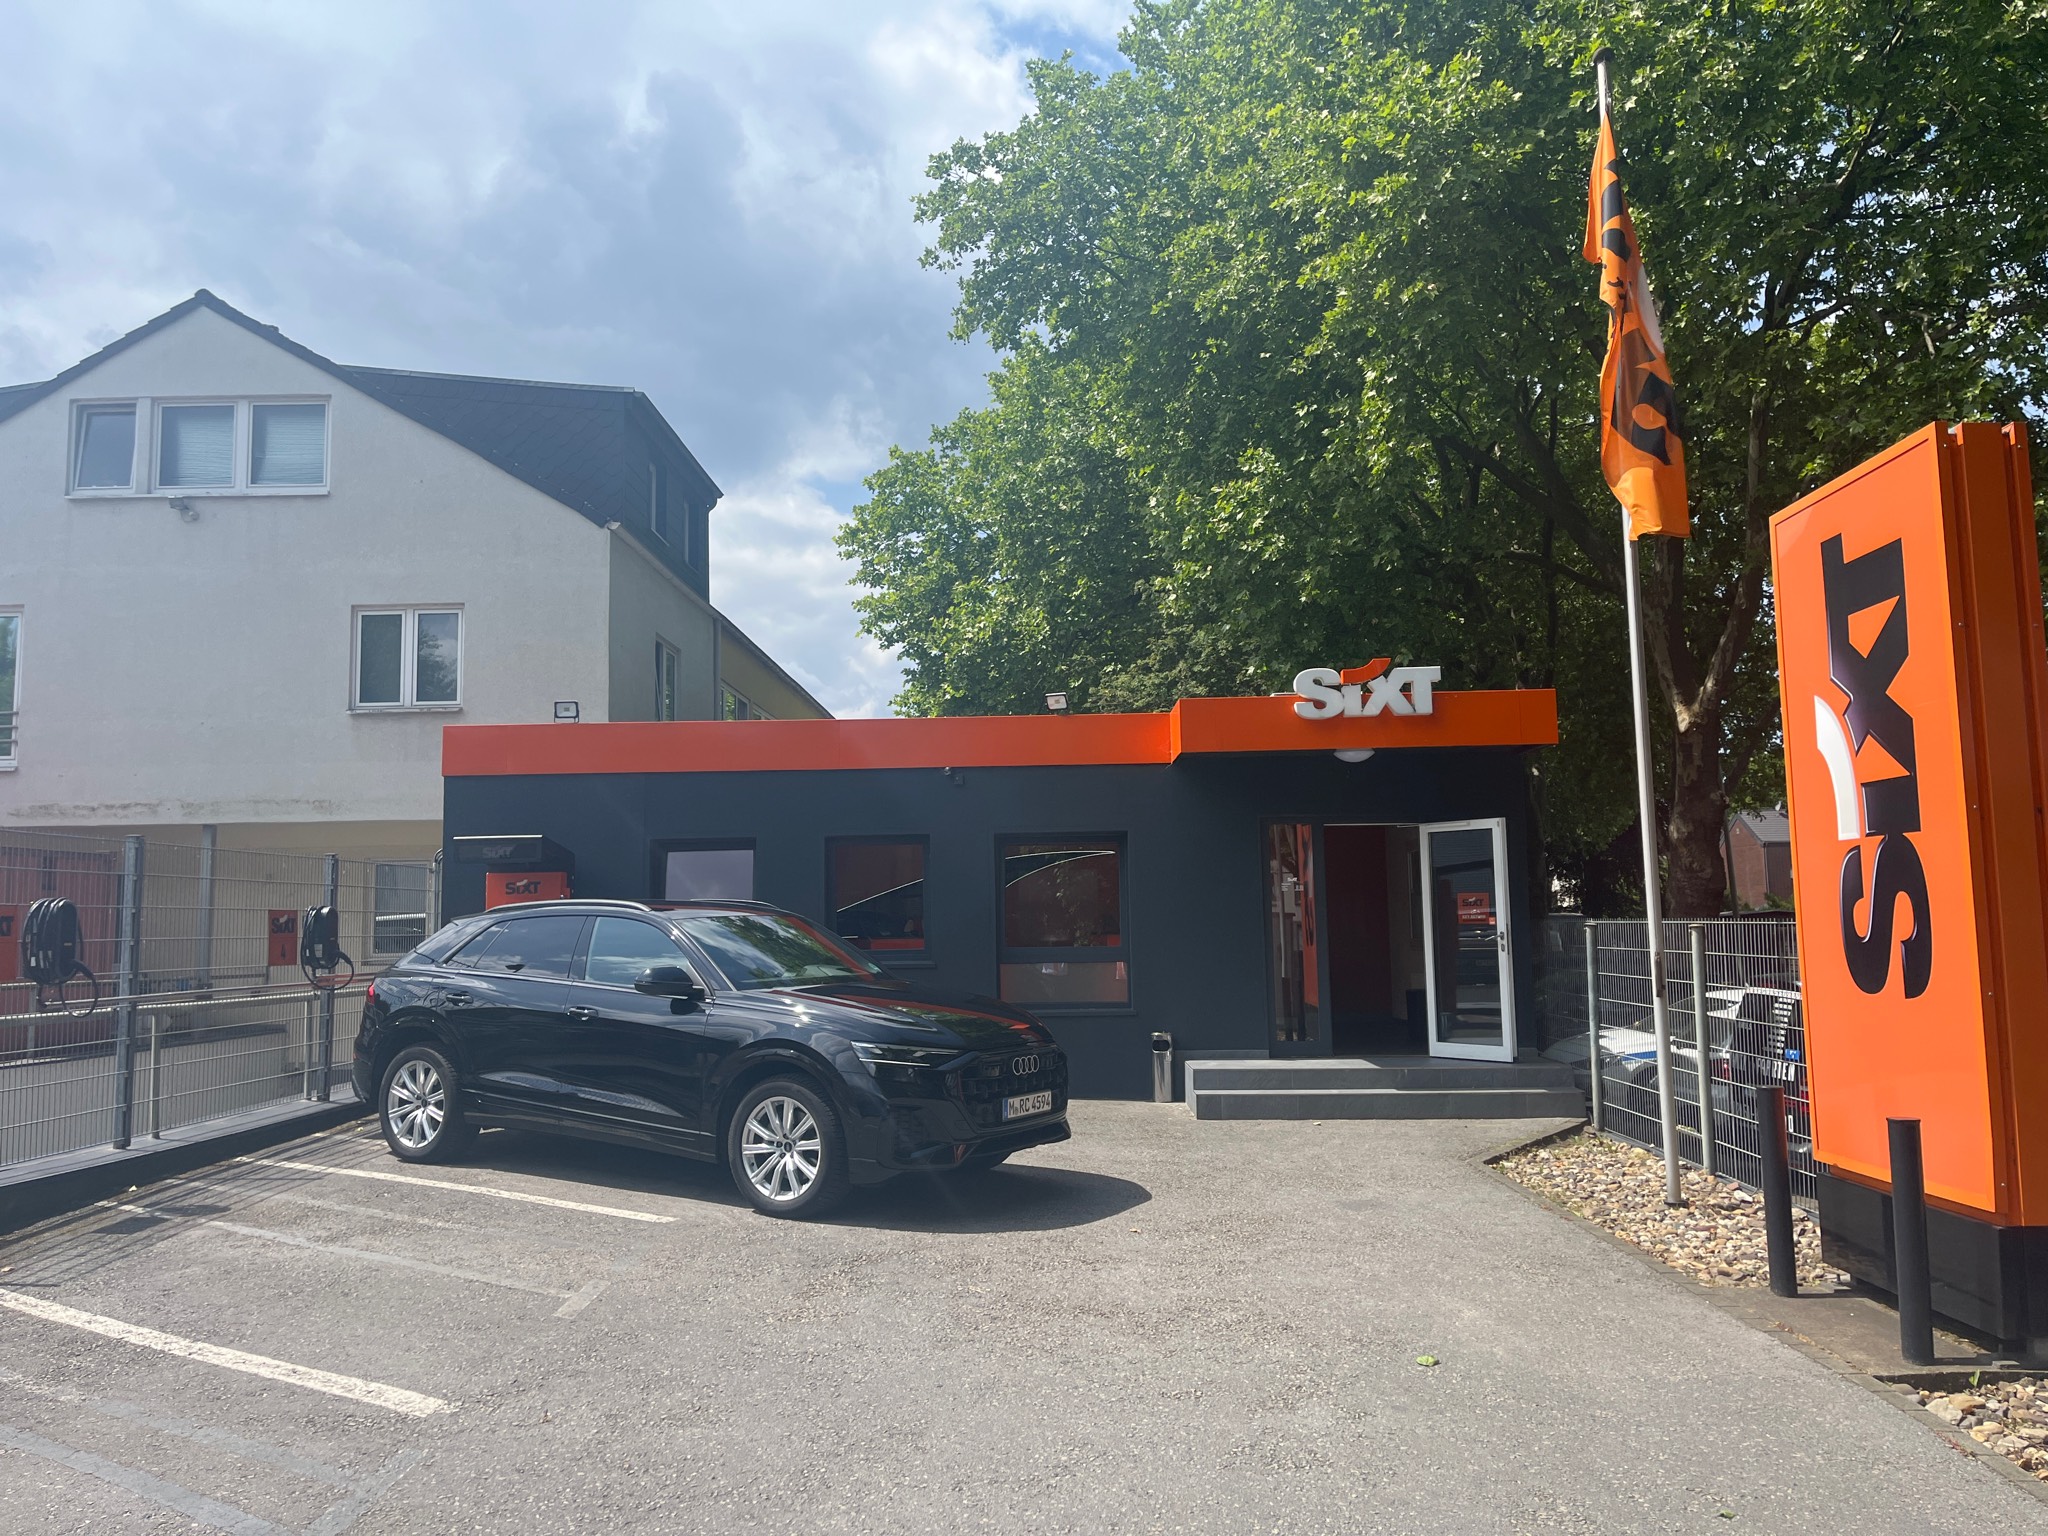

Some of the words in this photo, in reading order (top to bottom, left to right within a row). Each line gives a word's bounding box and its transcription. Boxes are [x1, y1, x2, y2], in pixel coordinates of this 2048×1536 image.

[1293, 658, 1442, 720] SIXT
[1814, 533, 1934, 999] SIXT
[505, 880, 541, 895] SIXT
[1019, 1098, 1030, 1113] RC
[1031, 1093, 1050, 1110] 4594
